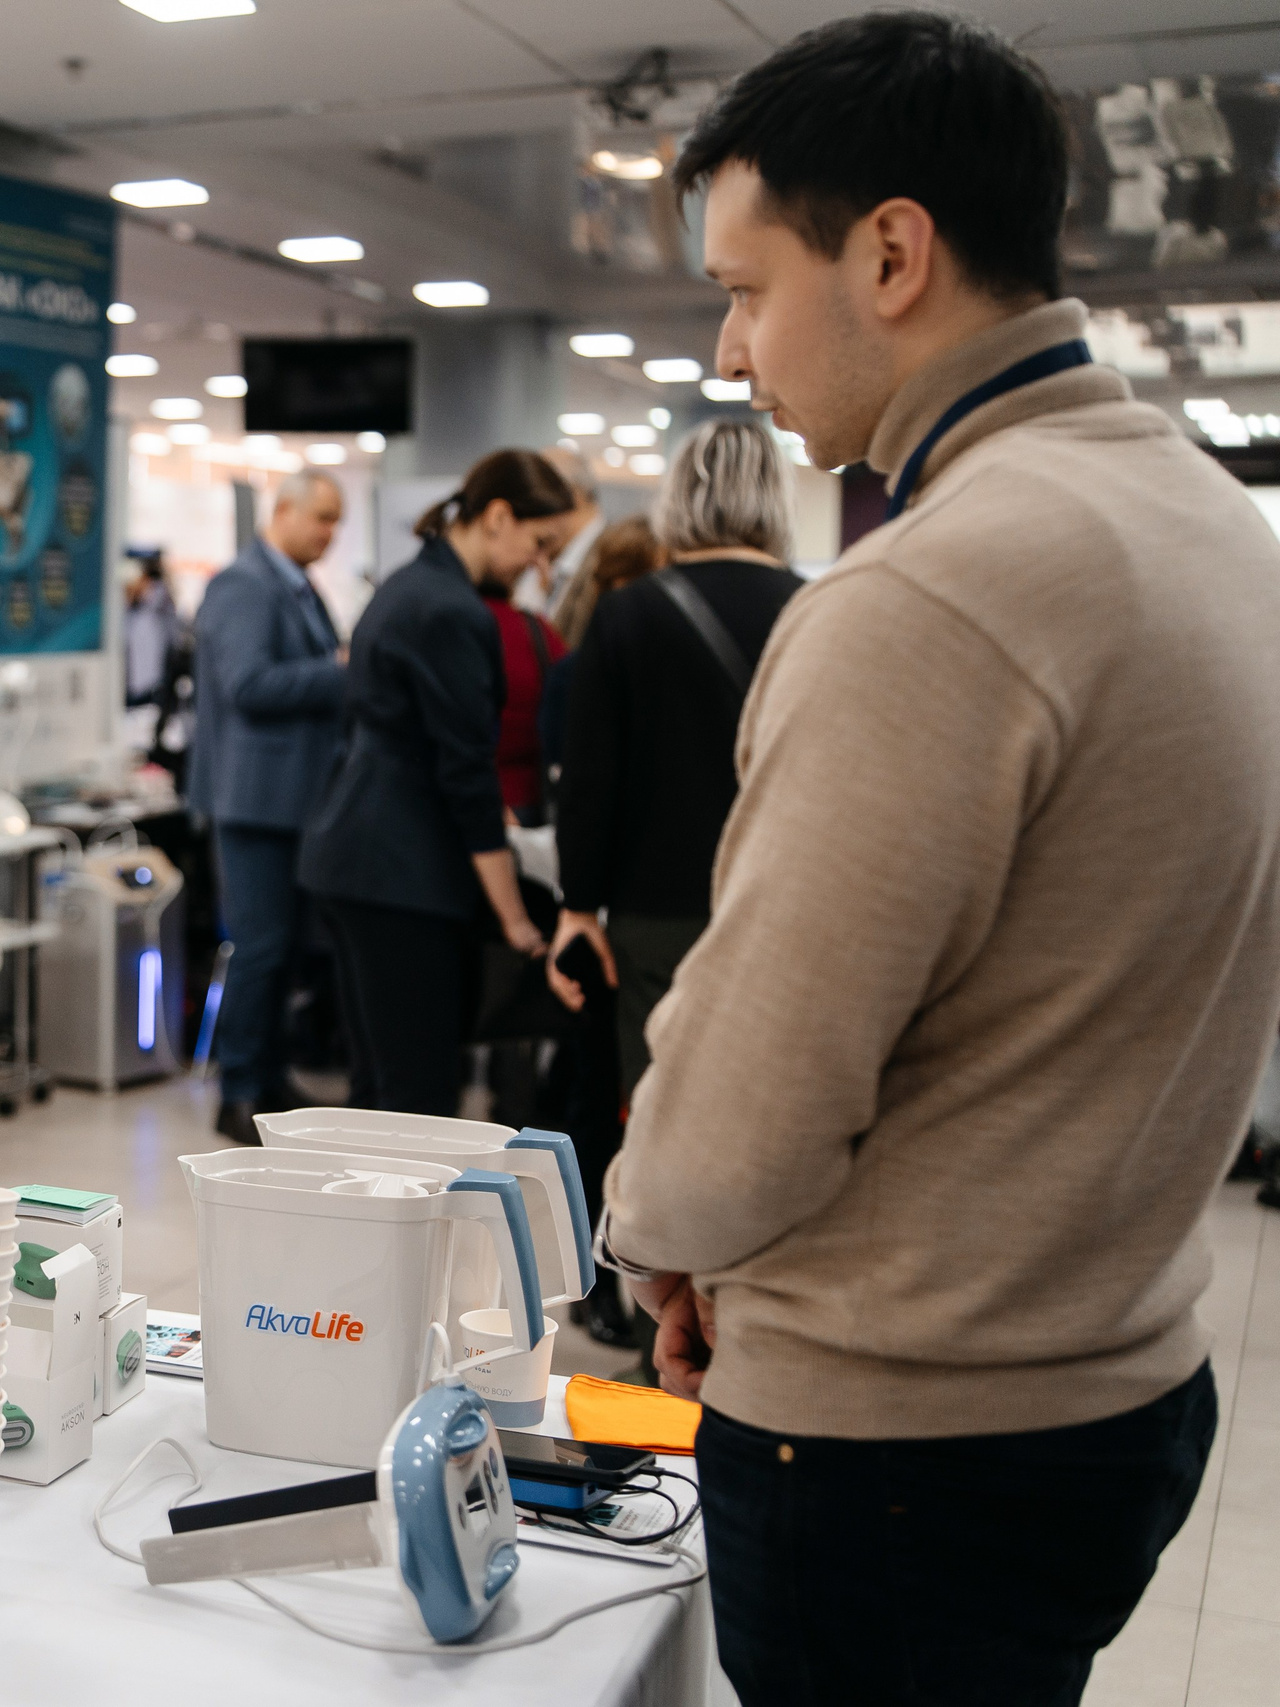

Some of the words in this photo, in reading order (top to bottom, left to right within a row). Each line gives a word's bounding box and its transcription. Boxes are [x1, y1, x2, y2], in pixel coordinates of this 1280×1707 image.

[246, 1304, 364, 1342] AkvaLife
[491, 1387, 514, 1397] ВОДУ
[60, 1410, 85, 1434] AKSON
